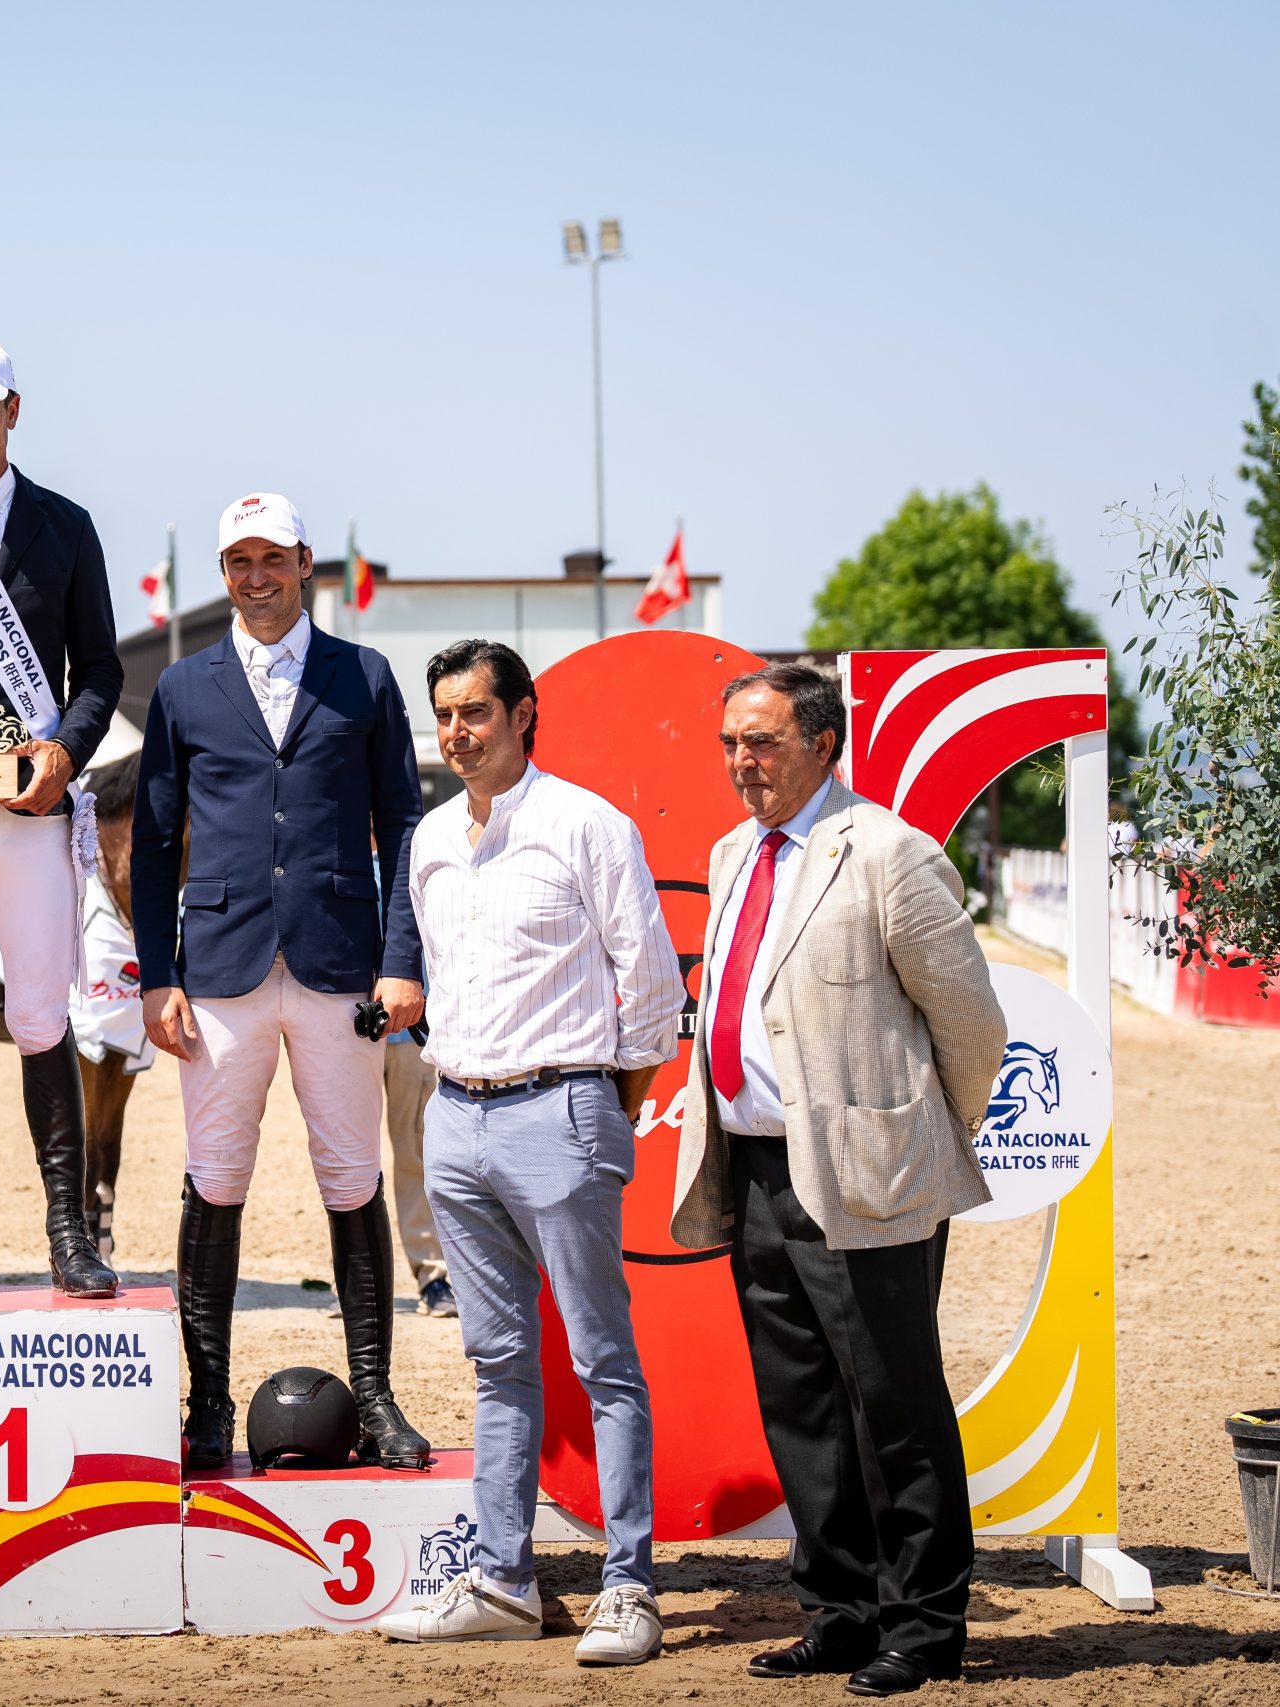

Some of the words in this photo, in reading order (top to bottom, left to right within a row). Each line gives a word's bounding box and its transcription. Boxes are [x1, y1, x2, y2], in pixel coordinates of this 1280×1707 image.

[3, 662, 26, 692] RFHE
[18, 691, 38, 719] 2024
[997, 1132, 1091, 1148] NACIONAL
[979, 1155, 1047, 1170] SALTOS
[1052, 1155, 1080, 1169] RFHE
[10, 1333, 146, 1359] NACIONAL
[91, 1363, 153, 1388] 2024
[322, 1518, 376, 1606] 3
